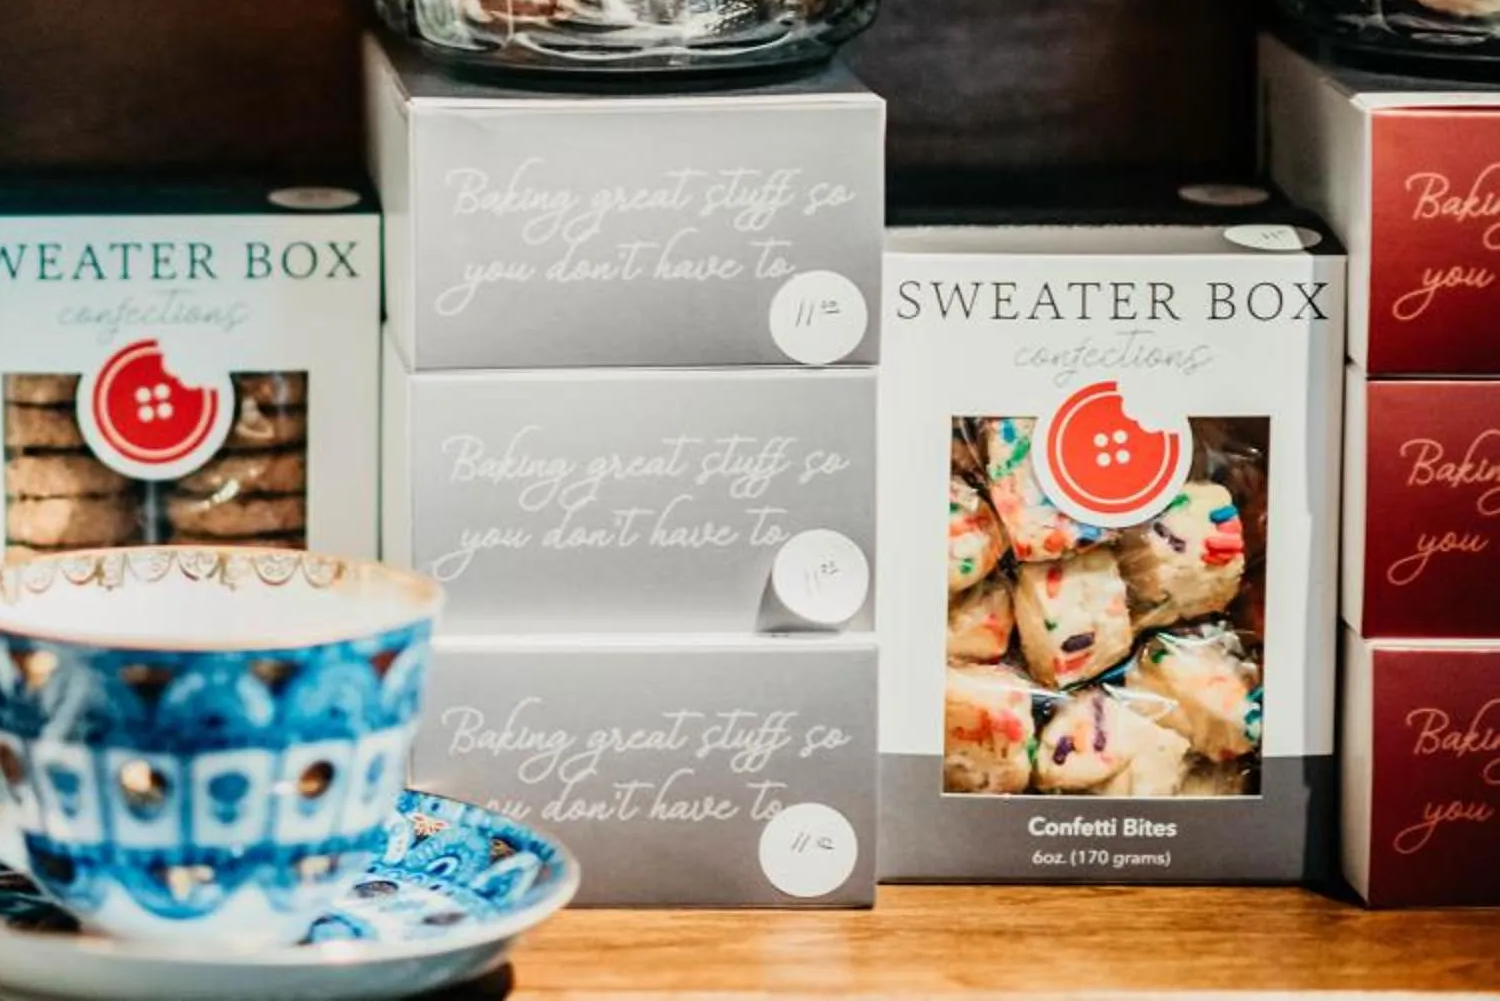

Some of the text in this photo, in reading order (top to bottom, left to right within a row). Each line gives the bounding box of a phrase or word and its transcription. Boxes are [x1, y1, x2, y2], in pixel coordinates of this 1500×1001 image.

[446, 158, 855, 245] Baking great stuff so
[1405, 163, 1500, 250] Baki
[245, 241, 360, 280] BOX
[434, 227, 795, 316] you don't have to
[57, 288, 251, 343] confections
[896, 280, 1330, 322] SWEATER BOX
[1393, 267, 1494, 320] you
[1013, 328, 1215, 388] confections
[442, 425, 849, 511] Baking great stuff so
[1400, 429, 1500, 515] Bakin
[432, 495, 791, 581] you don't have to
[1387, 531, 1489, 585] you
[441, 698, 852, 784] Baking great stuff so
[1406, 700, 1500, 785] Baki
[483, 769, 786, 822] ou don't have to
[1028, 817, 1178, 837] Confetti Bites
[1394, 801, 1494, 854] you
[1032, 850, 1172, 868] 6oz. (170 grams)
